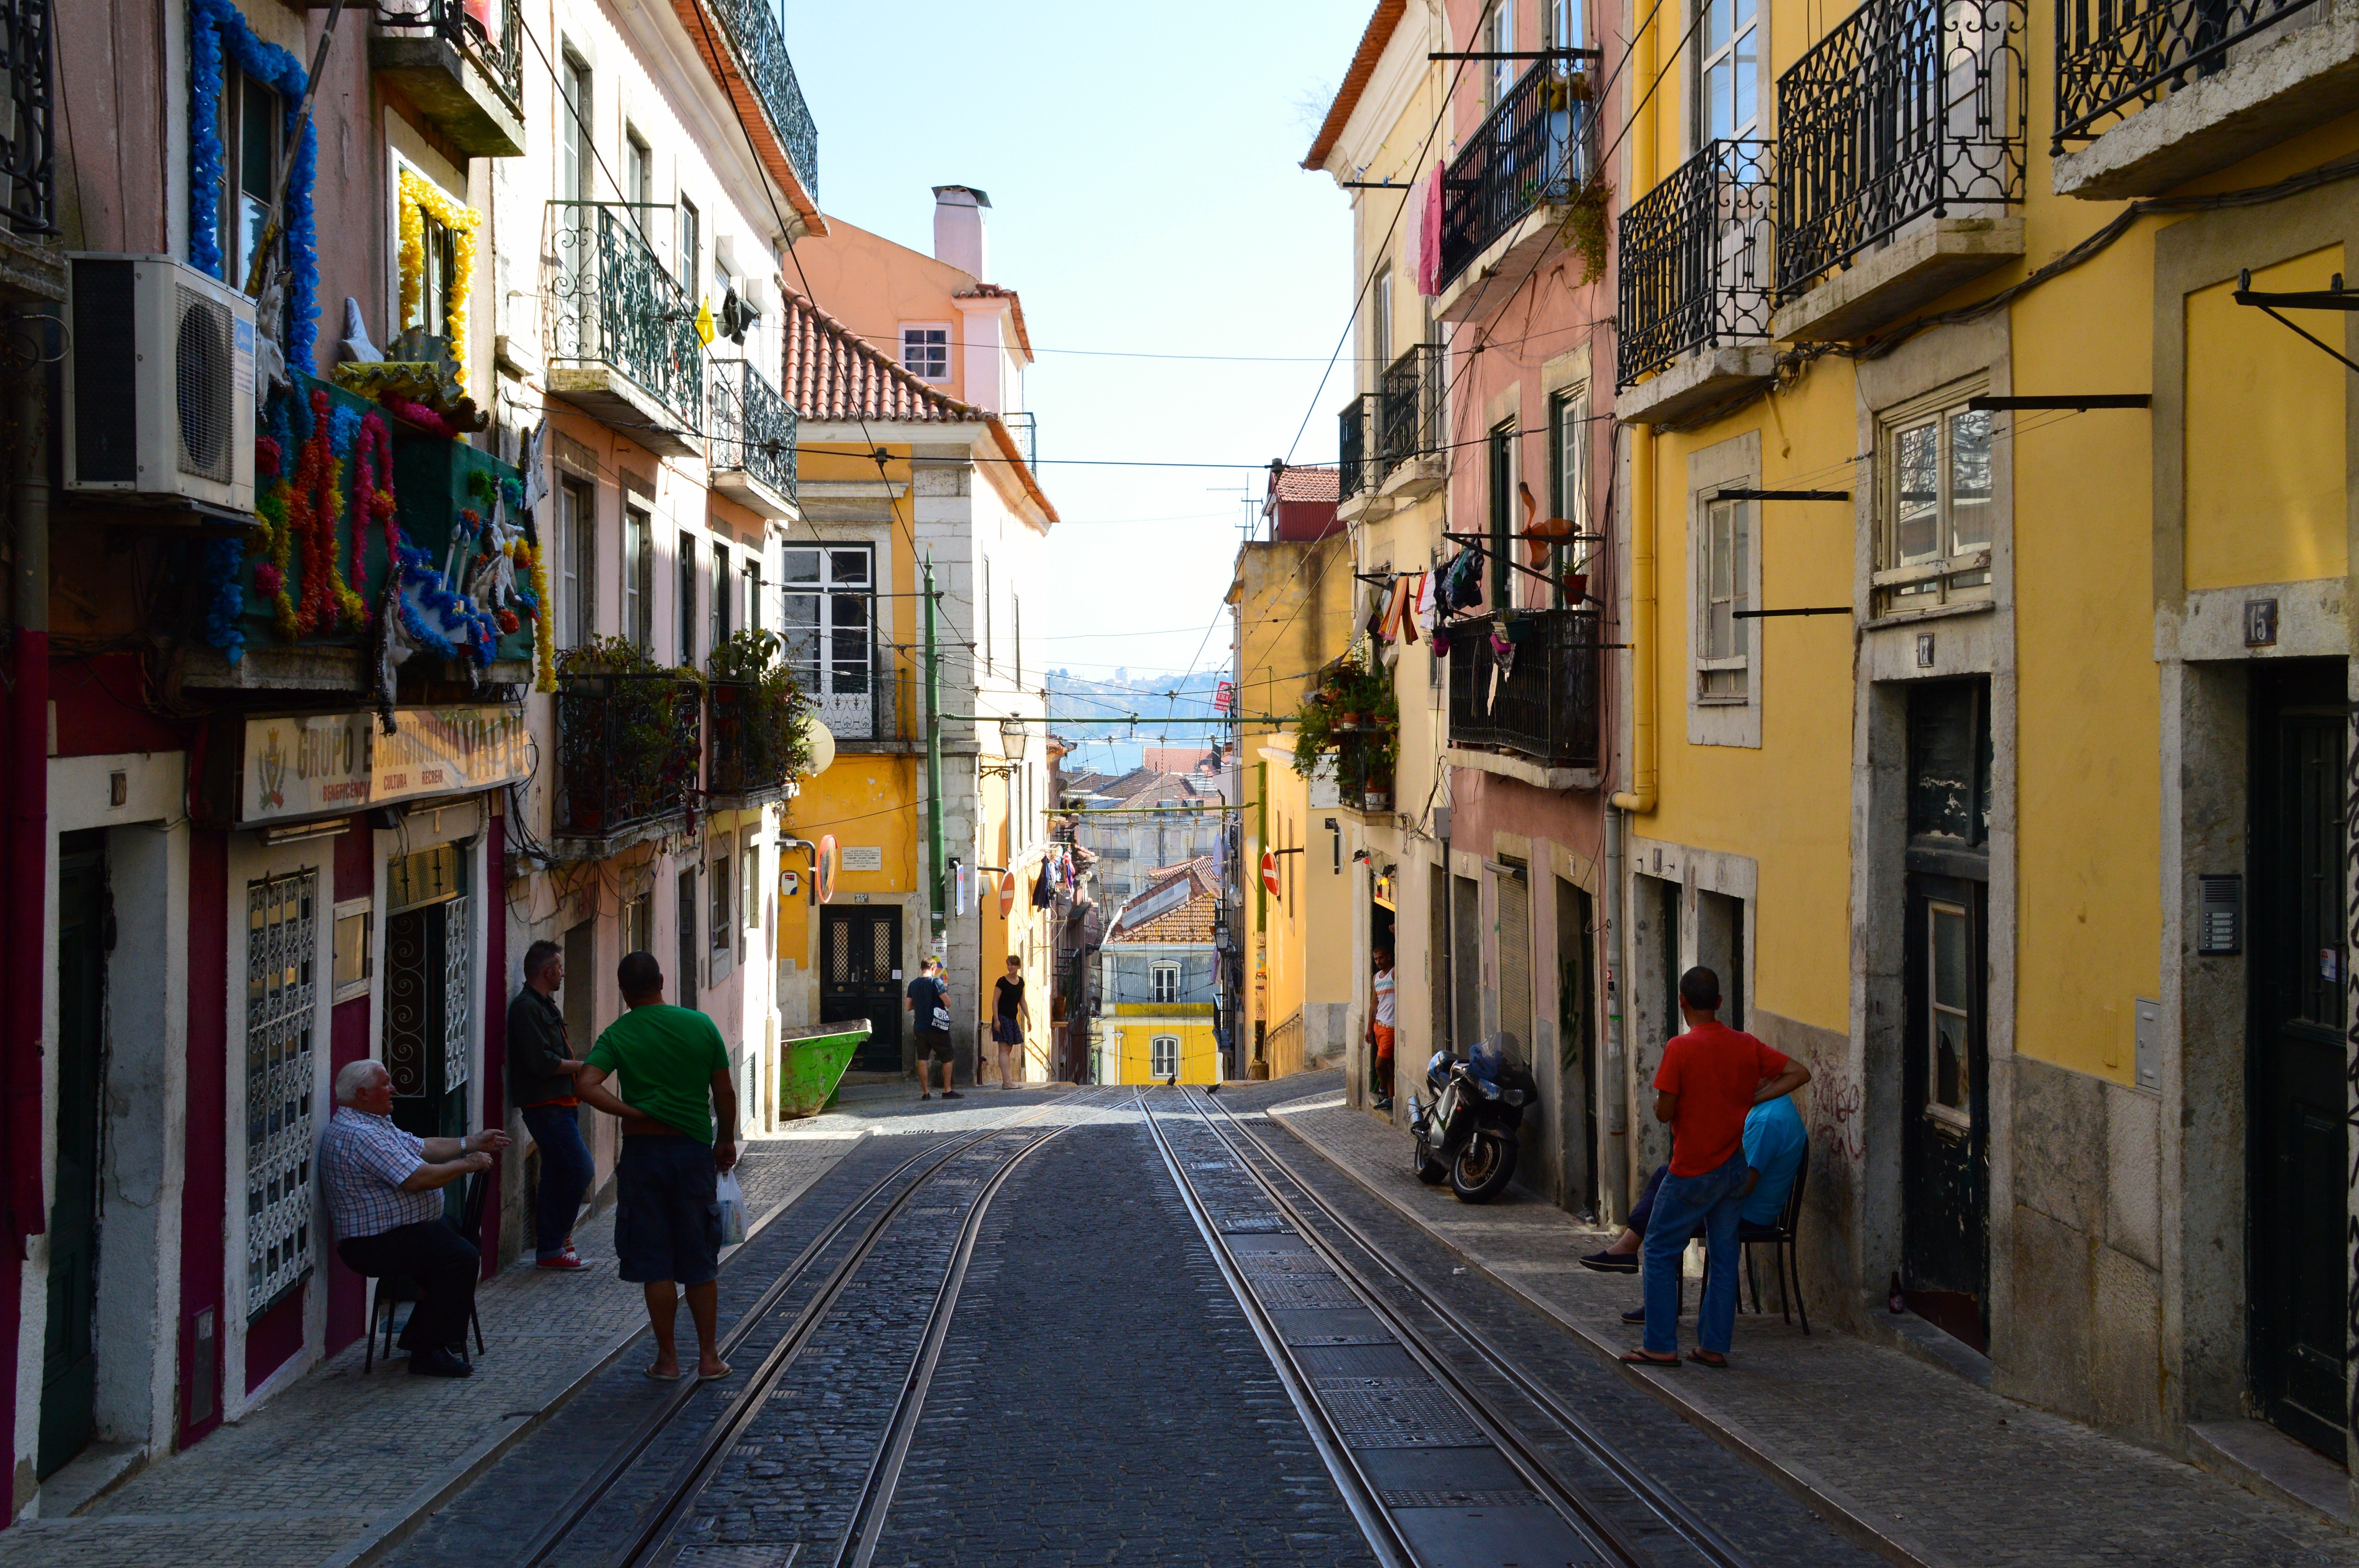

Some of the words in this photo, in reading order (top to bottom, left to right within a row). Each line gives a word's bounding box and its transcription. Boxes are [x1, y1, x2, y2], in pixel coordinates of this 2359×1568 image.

[2250, 605, 2267, 641] 15
[1919, 637, 1928, 663] 13
[297, 727, 353, 779] GRUPO
[363, 719, 460, 772] EXCURSIONISTA
[462, 718, 496, 780] VAI
[501, 716, 523, 771] TU
[323, 780, 371, 802] BENEFICÊNCIA
[384, 773, 407, 791] CULTURA
[422, 769, 443, 785] RECREIO
[933, 1018, 949, 1027] SINNBUS
